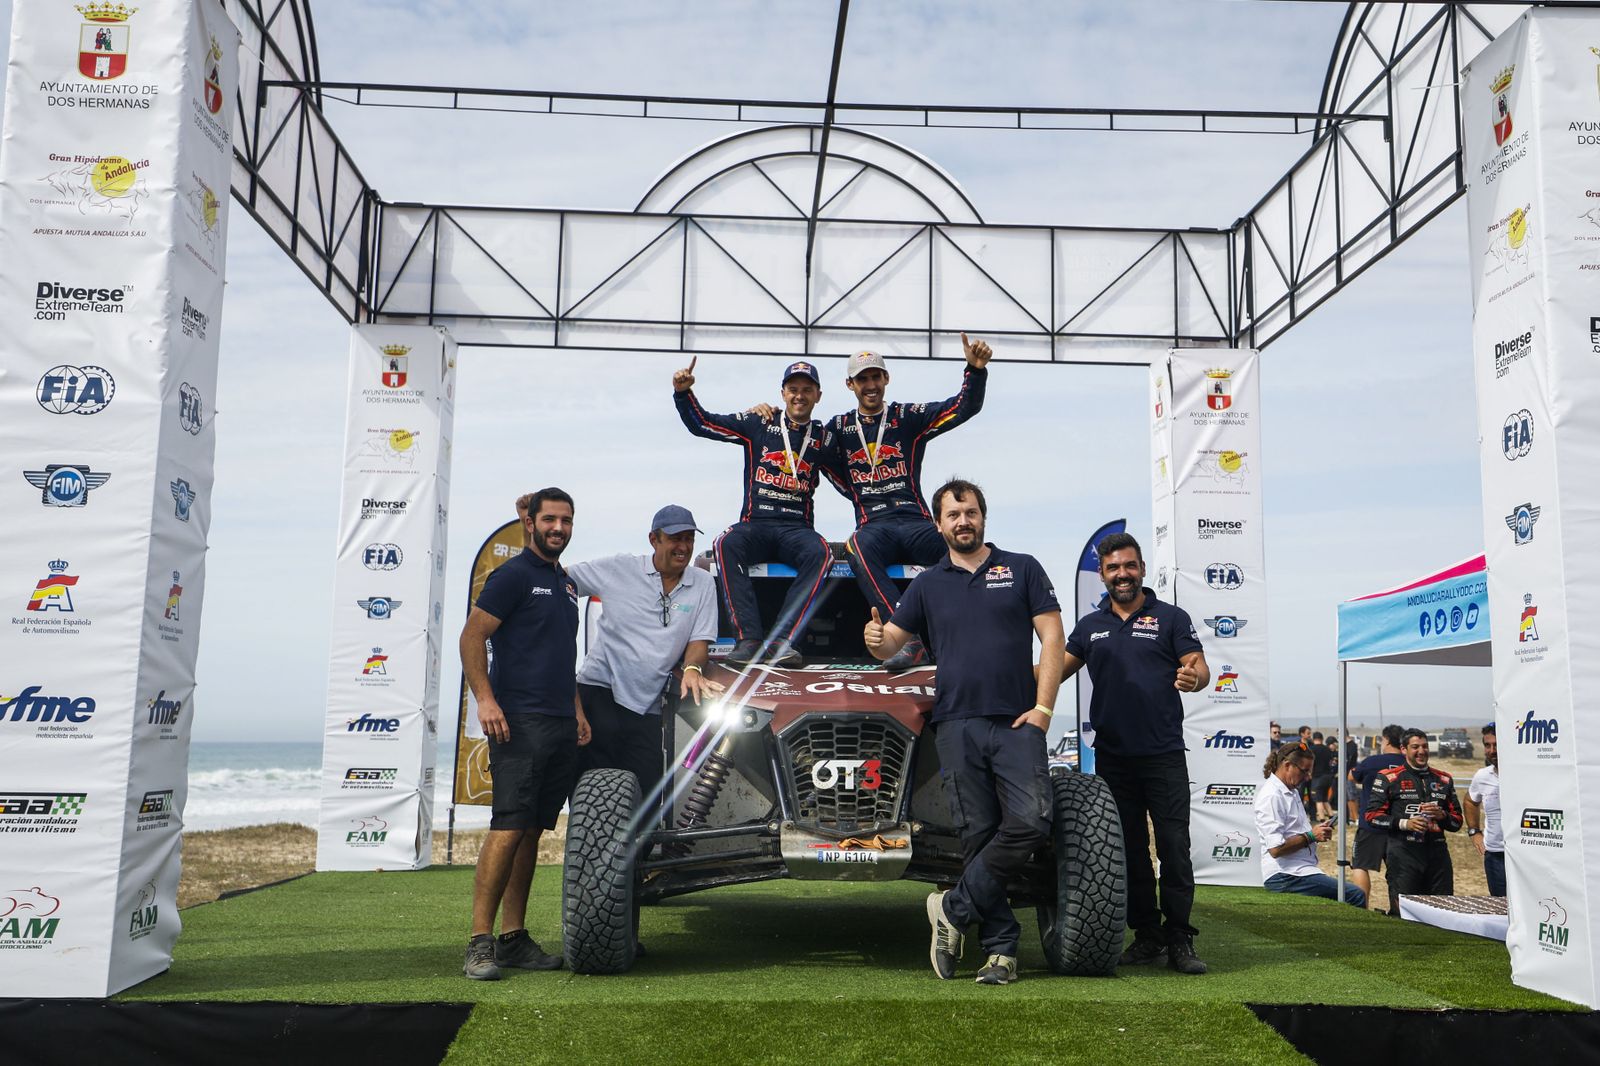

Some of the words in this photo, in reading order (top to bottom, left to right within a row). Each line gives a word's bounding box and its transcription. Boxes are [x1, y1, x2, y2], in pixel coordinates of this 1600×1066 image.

[39, 82, 138, 95] AYUNTAMIENTO
[141, 84, 158, 95] DE
[48, 96, 76, 107] DOS
[79, 97, 150, 109] HERMANAS
[1568, 121, 1600, 131] AYUN
[49, 153, 71, 162] Gran
[74, 155, 122, 165] Hipódromo
[1497, 146, 1527, 174] ERMANAS
[32, 228, 63, 236] APUESTA
[36, 282, 124, 302] Diverse
[35, 298, 123, 314] ExtremeTeam
[33, 310, 65, 321] .com
[1495, 330, 1532, 360] Diverse
[1495, 345, 1532, 370] ExtremeTeam
[416, 390, 425, 398] DE
[755, 466, 785, 488] Red
[784, 475, 809, 493] Bll
[850, 468, 879, 484] Red
[880, 461, 907, 480] Bull
[52, 477, 81, 495] FIM
[362, 498, 407, 509] Diverse
[1198, 518, 1242, 529] Diverse
[27, 618, 61, 626] Federación
[63, 619, 92, 627] Española
[31, 627, 80, 635] Automovilismo
[805, 681, 936, 697] Qatar
[347, 713, 400, 732] rfme
[1515, 710, 1559, 744] rfme
[1203, 730, 1255, 749] rfme
[33, 817, 78, 825] andaluza
[346, 831, 388, 842] FAM
[825, 852, 840, 862] NP
[1212, 846, 1251, 857] FAM
[129, 905, 158, 932] FAM
[0, 917, 61, 938] AM
[1538, 922, 1569, 947] FAM
